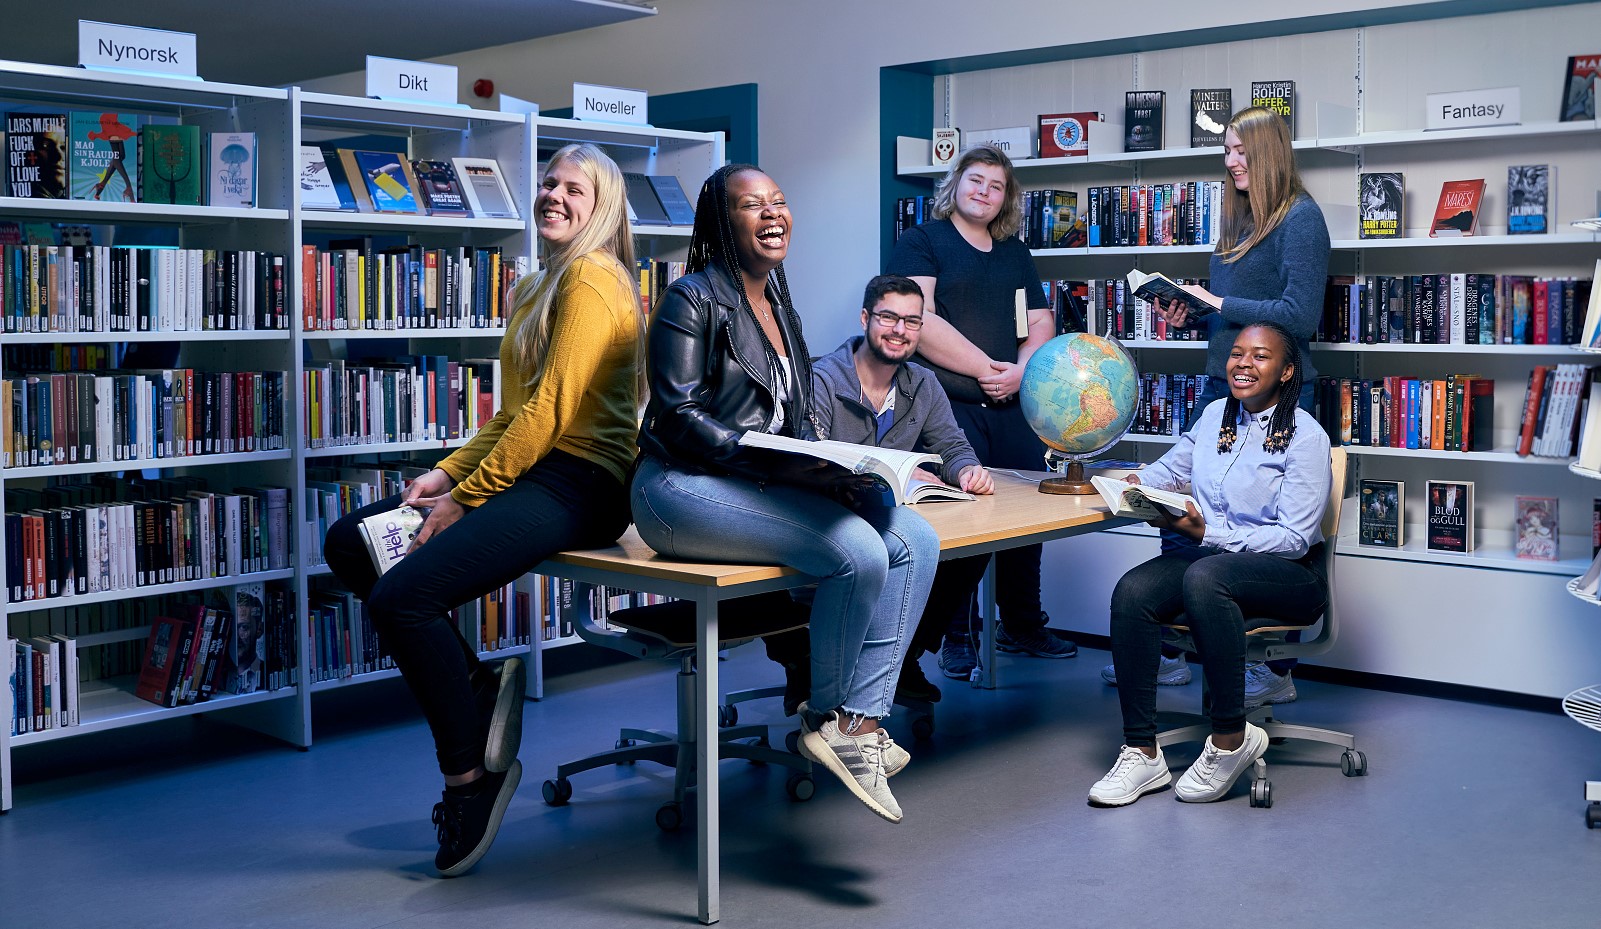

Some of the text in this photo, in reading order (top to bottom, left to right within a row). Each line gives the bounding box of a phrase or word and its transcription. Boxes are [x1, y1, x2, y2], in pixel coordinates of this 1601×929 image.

[98, 38, 178, 64] Nynorsk
[399, 73, 428, 92] Dikt
[1193, 91, 1230, 102] MINETTE
[1252, 88, 1291, 99] ROHDE
[585, 97, 636, 116] Noveller
[1193, 101, 1230, 111] WALTERS
[1252, 97, 1288, 107] OFFER-
[1442, 103, 1504, 120] Fantasy
[8, 118, 66, 133] LARS MÆHLE
[9, 136, 35, 151] FUCK
[74, 141, 94, 149] MAO
[10, 151, 26, 167] OFF
[88, 151, 120, 159] RAUDE
[81, 158, 110, 167] KJOLE
[11, 166, 41, 182] I LOVE
[229, 175, 247, 187] dagar
[11, 182, 32, 198] YOU
[1362, 220, 1397, 229] HARRY POTTER
[1435, 506, 1460, 516] BLOD
[1440, 515, 1465, 526] GULL
[381, 521, 407, 561] Help
[1362, 531, 1397, 541] CLARE
